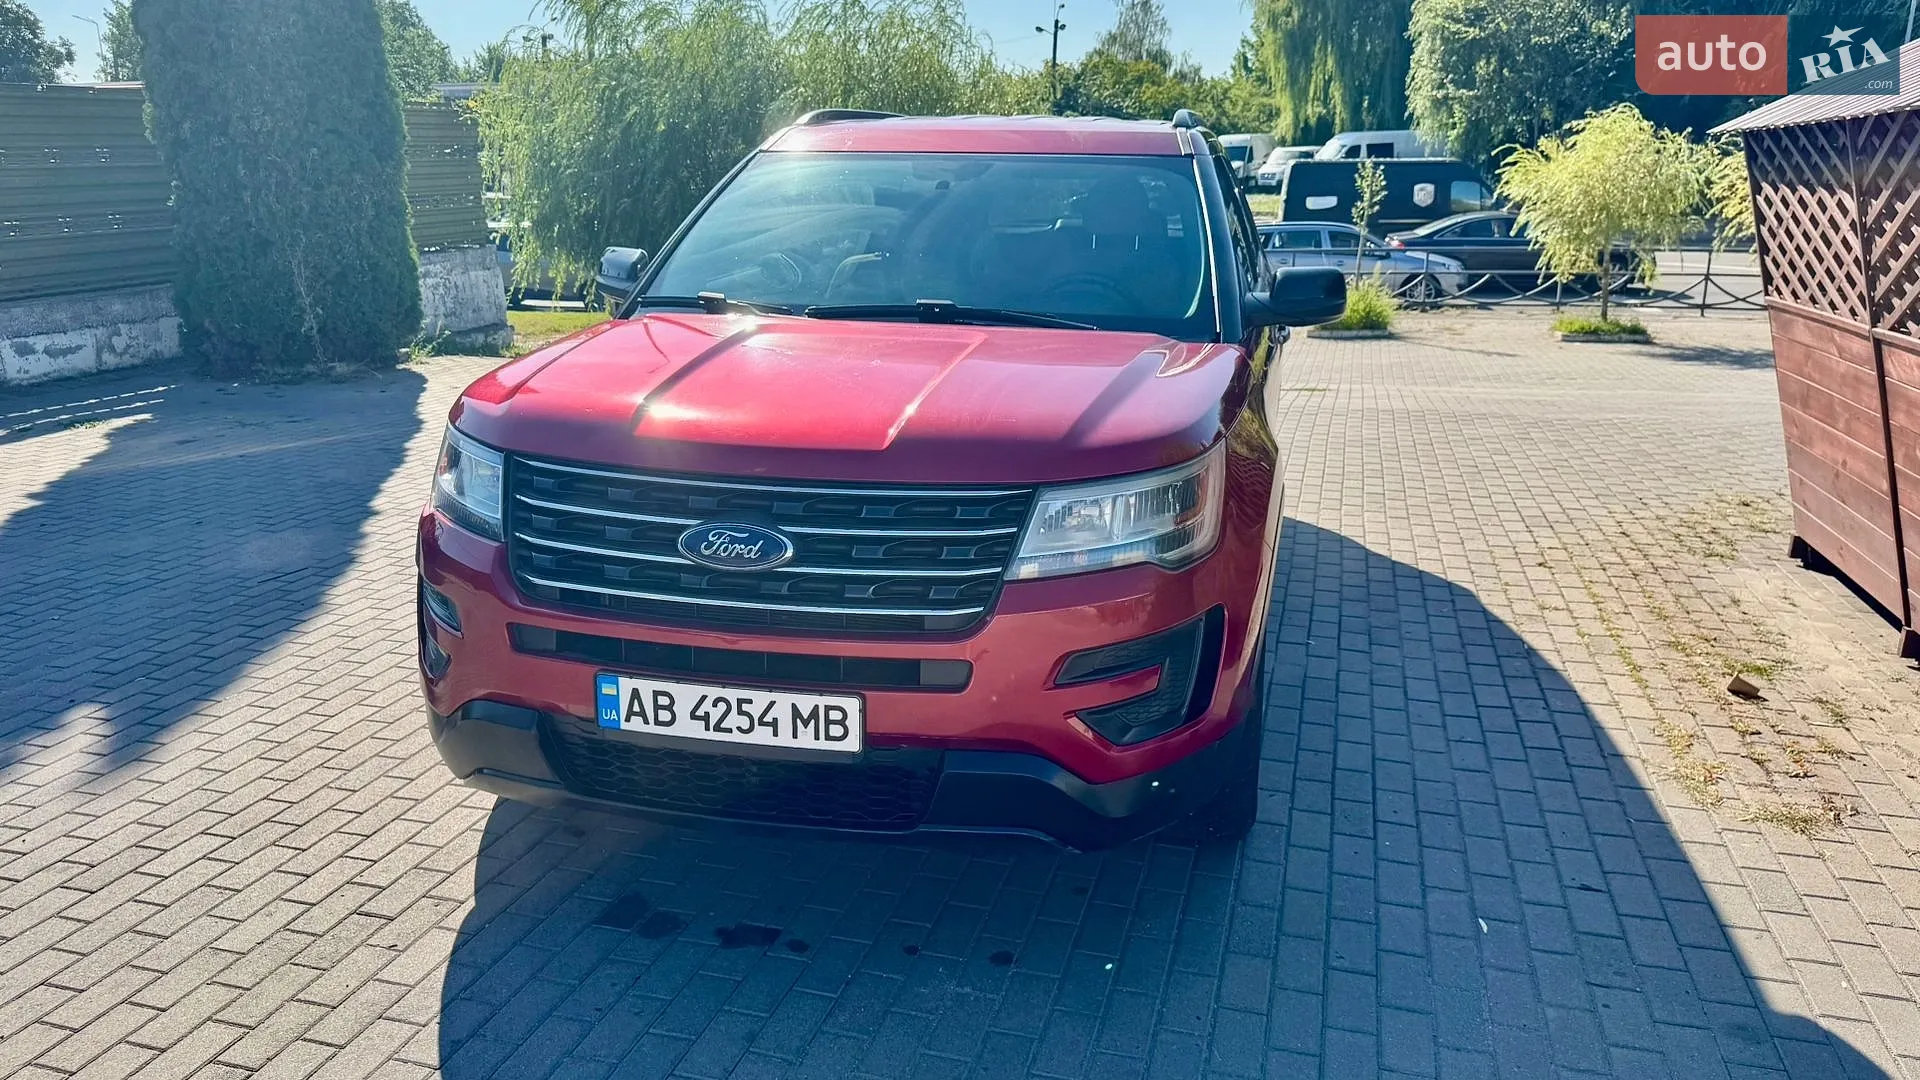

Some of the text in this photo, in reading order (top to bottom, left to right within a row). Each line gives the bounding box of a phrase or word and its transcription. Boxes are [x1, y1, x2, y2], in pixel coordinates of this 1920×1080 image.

[700, 529, 764, 559] Ford
[602, 708, 618, 720] UA
[624, 687, 849, 742] AB 4254 MB
